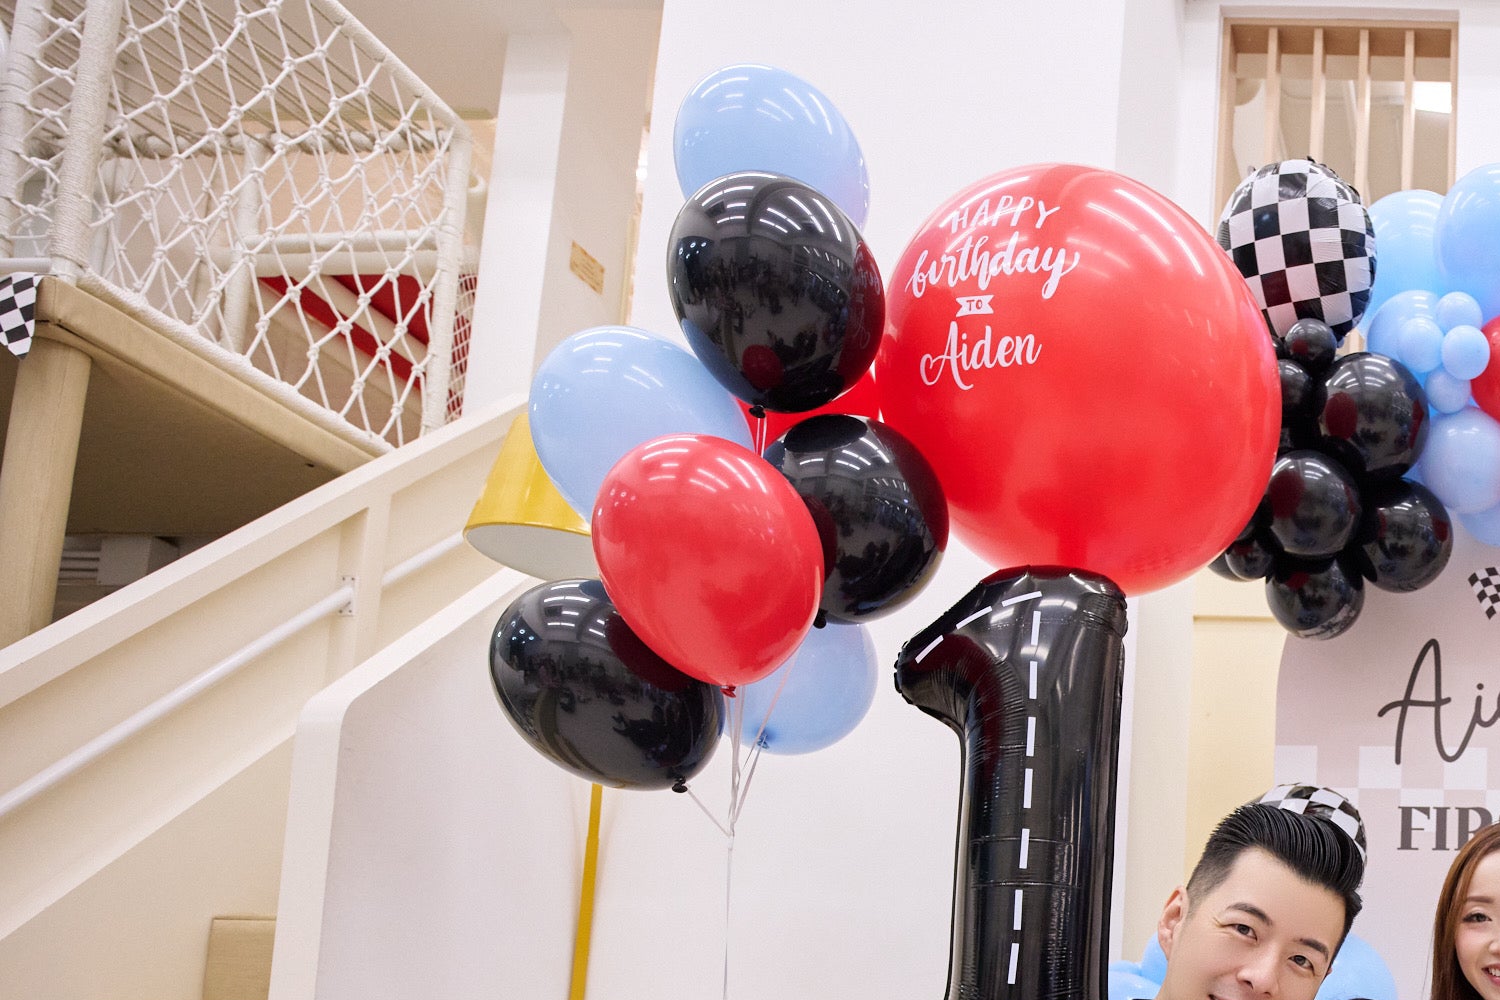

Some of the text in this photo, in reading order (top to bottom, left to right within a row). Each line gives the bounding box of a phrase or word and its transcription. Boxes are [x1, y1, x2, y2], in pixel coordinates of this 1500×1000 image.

[951, 195, 1060, 233] HAPPY
[905, 231, 1081, 300] birthday
[966, 298, 984, 312] TO
[919, 320, 1043, 390] Aiden
